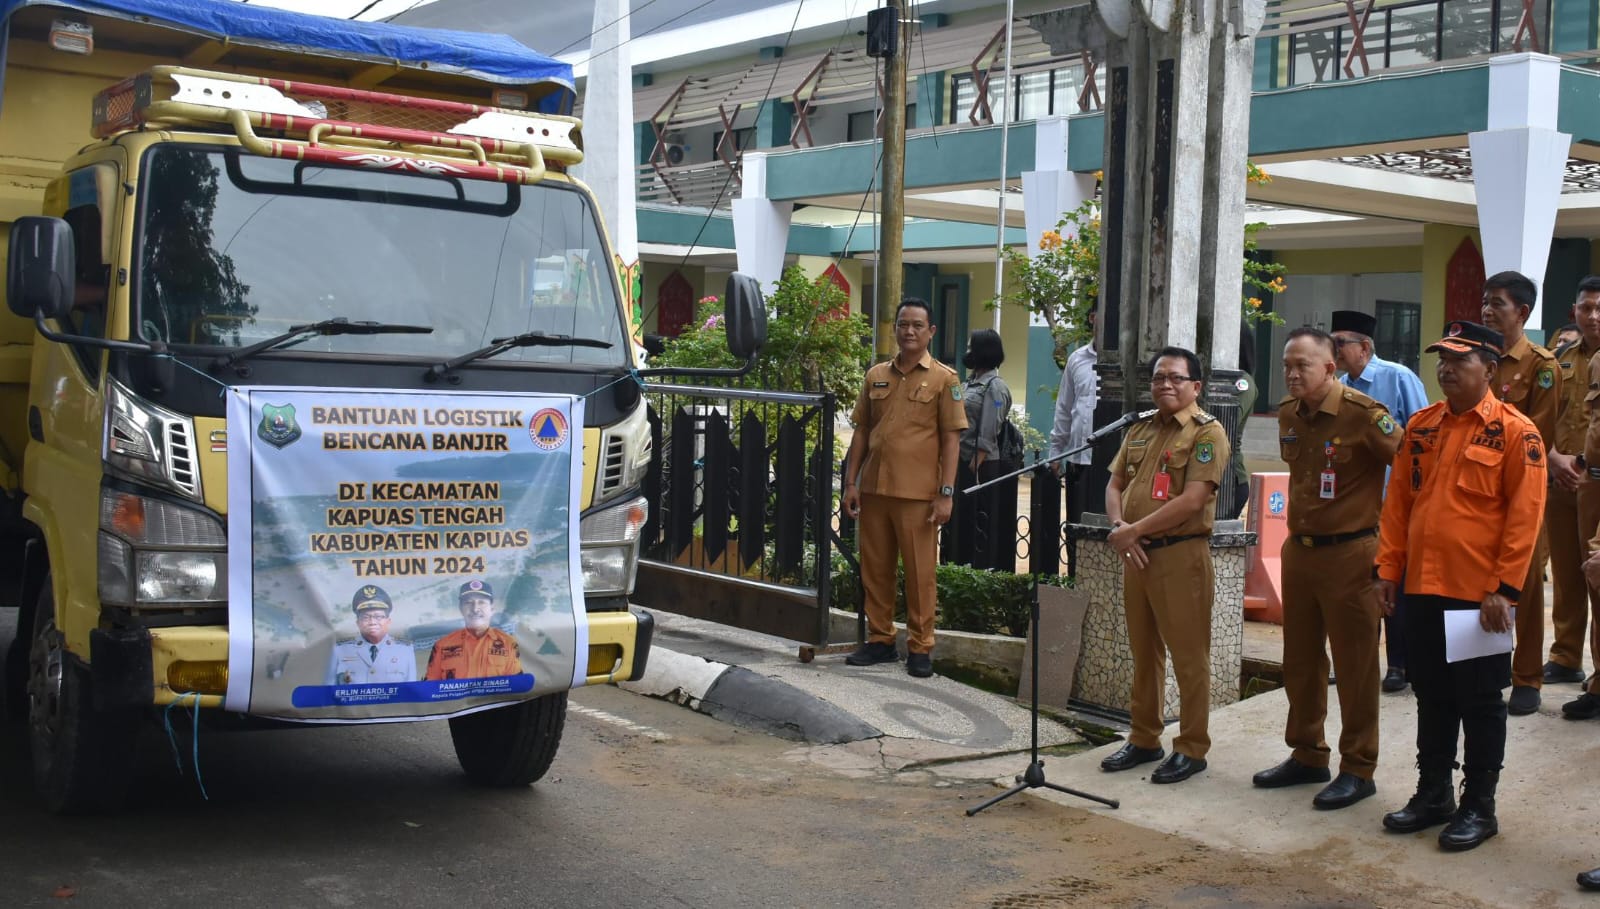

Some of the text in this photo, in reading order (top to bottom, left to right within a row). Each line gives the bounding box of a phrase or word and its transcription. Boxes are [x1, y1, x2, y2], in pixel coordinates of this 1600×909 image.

[312, 407, 417, 427] BANTUAN
[423, 408, 523, 427] LOGISTIK
[323, 433, 509, 451] BENCANA BANJIR
[338, 482, 500, 501] DI KECAMATAN
[328, 507, 503, 526] KAPUAS TENGAH
[311, 531, 529, 552] KABUPATEN KAPUAS
[352, 556, 485, 577] TAHUN 2024
[335, 688, 359, 697] ERLIN
[439, 679, 510, 690] PANAHATAN SINAGA
